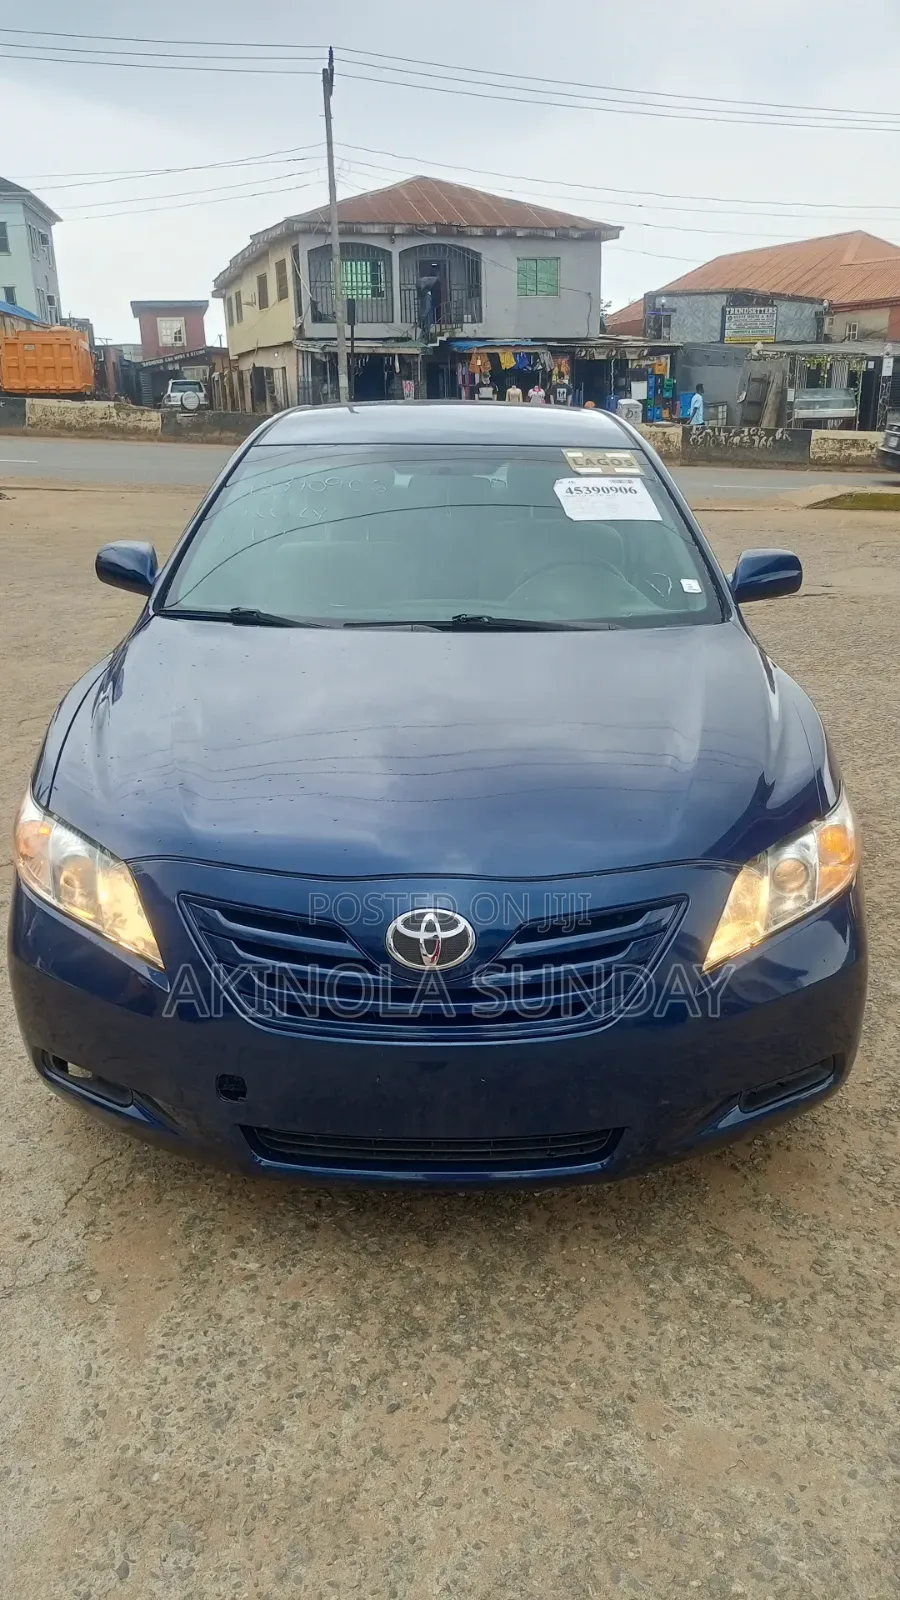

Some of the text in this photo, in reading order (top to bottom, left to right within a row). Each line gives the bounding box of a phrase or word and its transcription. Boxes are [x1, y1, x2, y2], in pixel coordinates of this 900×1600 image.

[725, 307, 777, 315] TRENDSETTERS
[571, 458, 635, 467] LAGOS
[565, 486, 638, 495] 45390906
